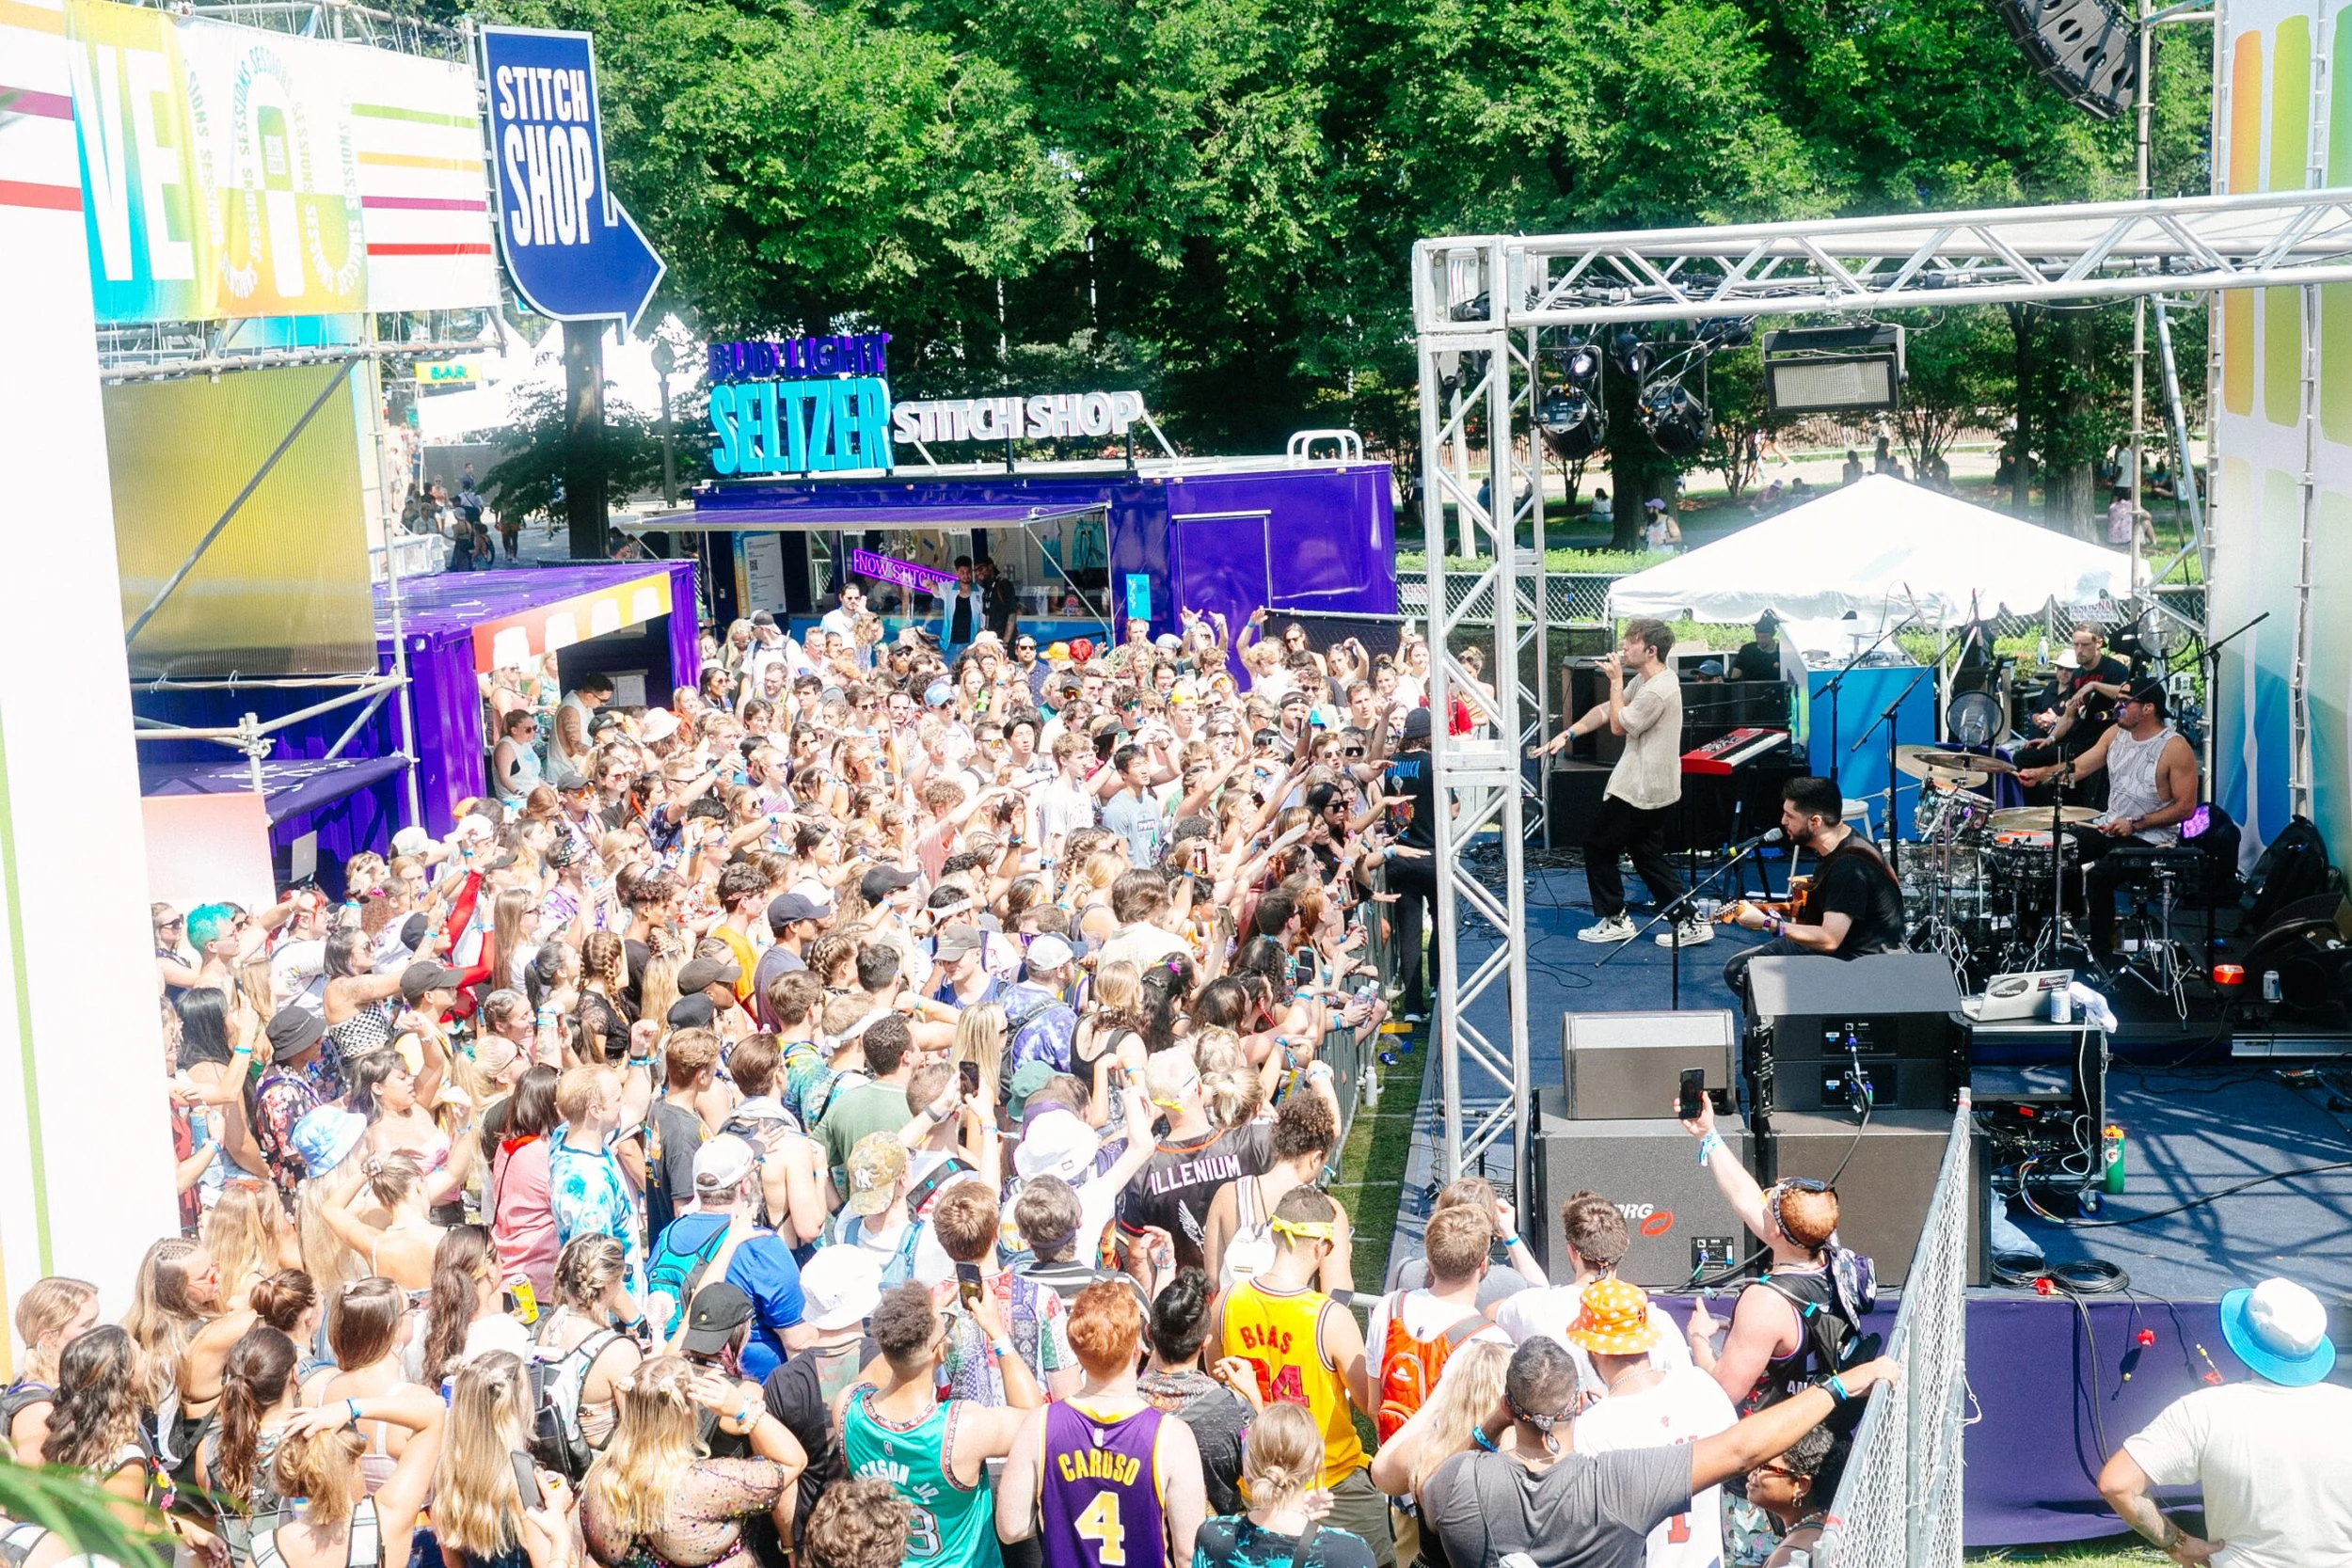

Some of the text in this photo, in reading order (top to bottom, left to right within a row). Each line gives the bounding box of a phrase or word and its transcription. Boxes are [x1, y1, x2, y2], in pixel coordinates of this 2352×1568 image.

[496, 65, 590, 122] STITCH
[503, 123, 596, 247] SHOP
[430, 365, 469, 380] BAR
[708, 333, 889, 379] BUD LIGHT
[710, 377, 895, 475] SELTZER
[892, 390, 1144, 443] STITCH SHOP
[859, 553, 955, 587] NOW STITC
[1150, 1153, 1242, 1196] ILLENIUM
[1240, 1323, 1293, 1354] BIAS
[1057, 1448, 1141, 1486] CARUSO
[1073, 1490, 1126, 1567] 4
